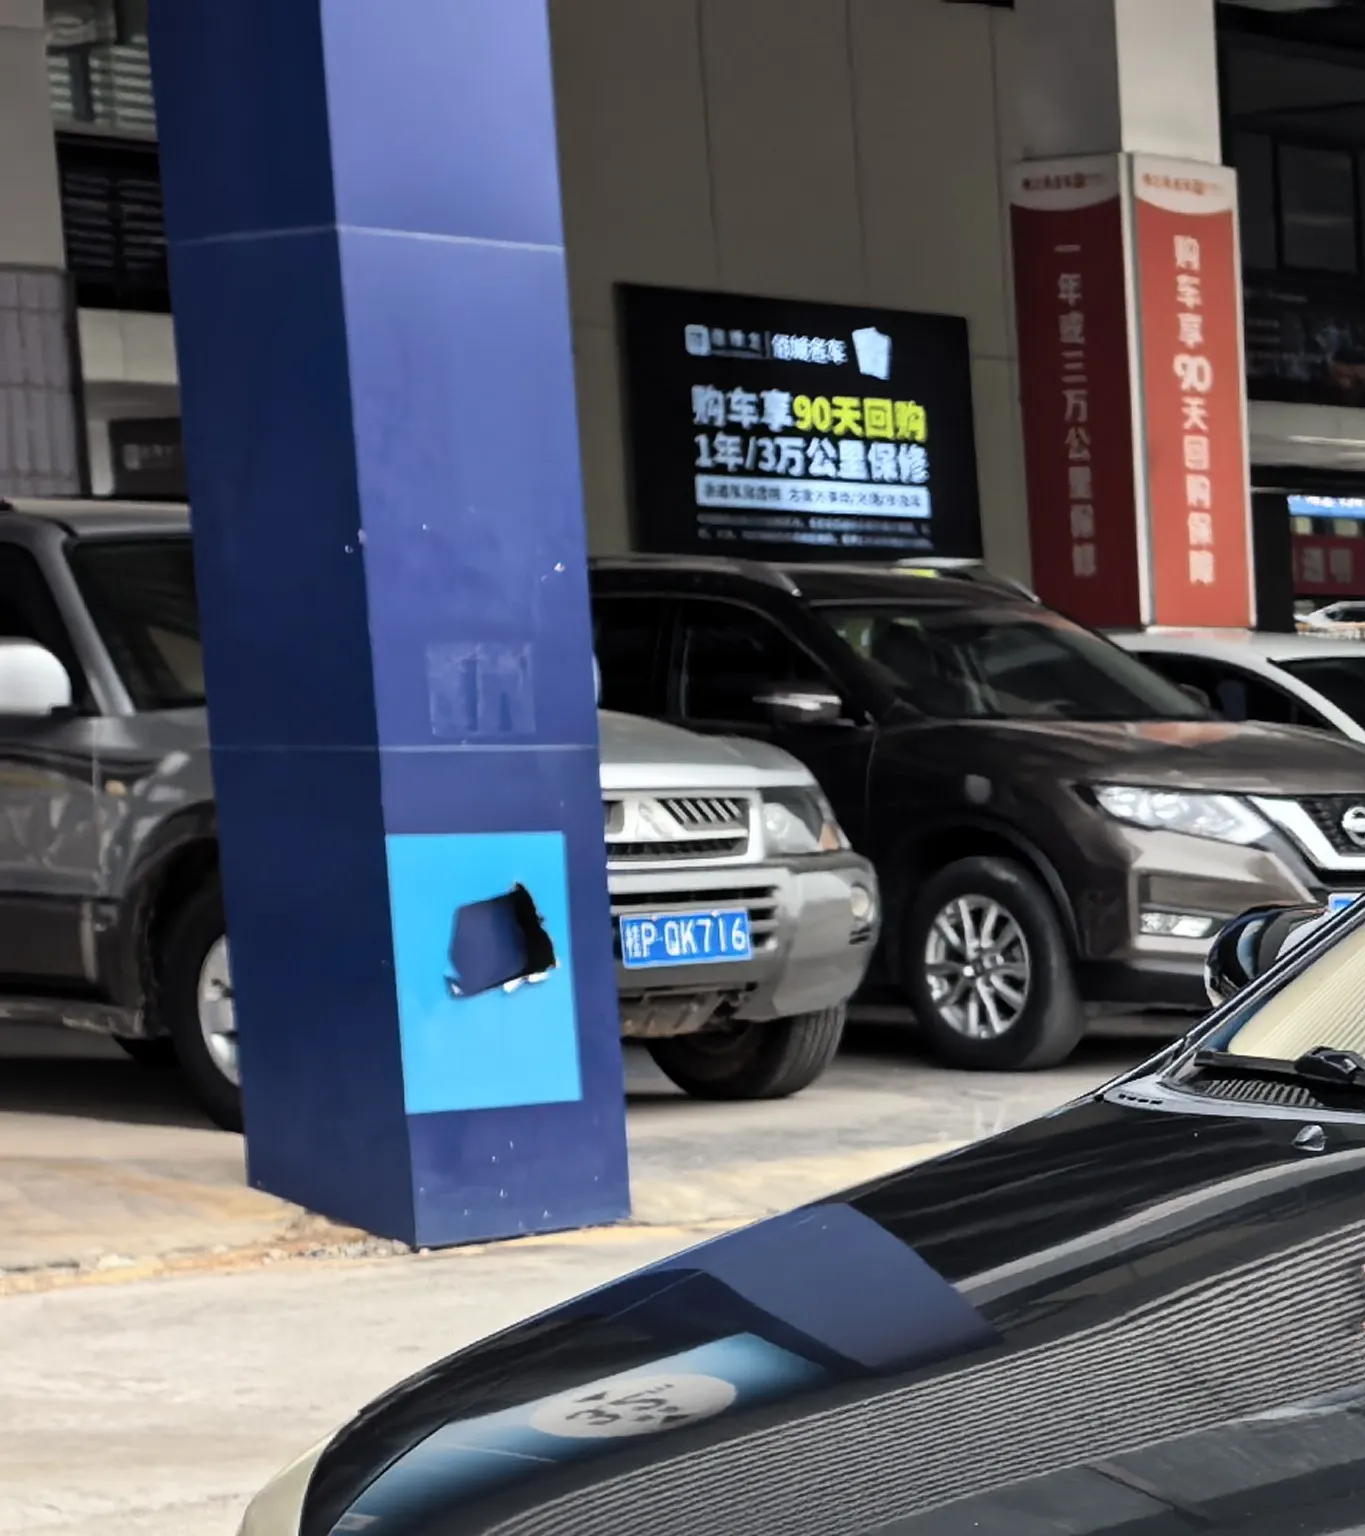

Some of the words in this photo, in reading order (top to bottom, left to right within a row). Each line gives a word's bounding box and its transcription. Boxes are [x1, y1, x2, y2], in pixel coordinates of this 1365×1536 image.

[691, 384, 927, 443] 购车享90天回购
[694, 431, 930, 484] 1年/3万公里保修
